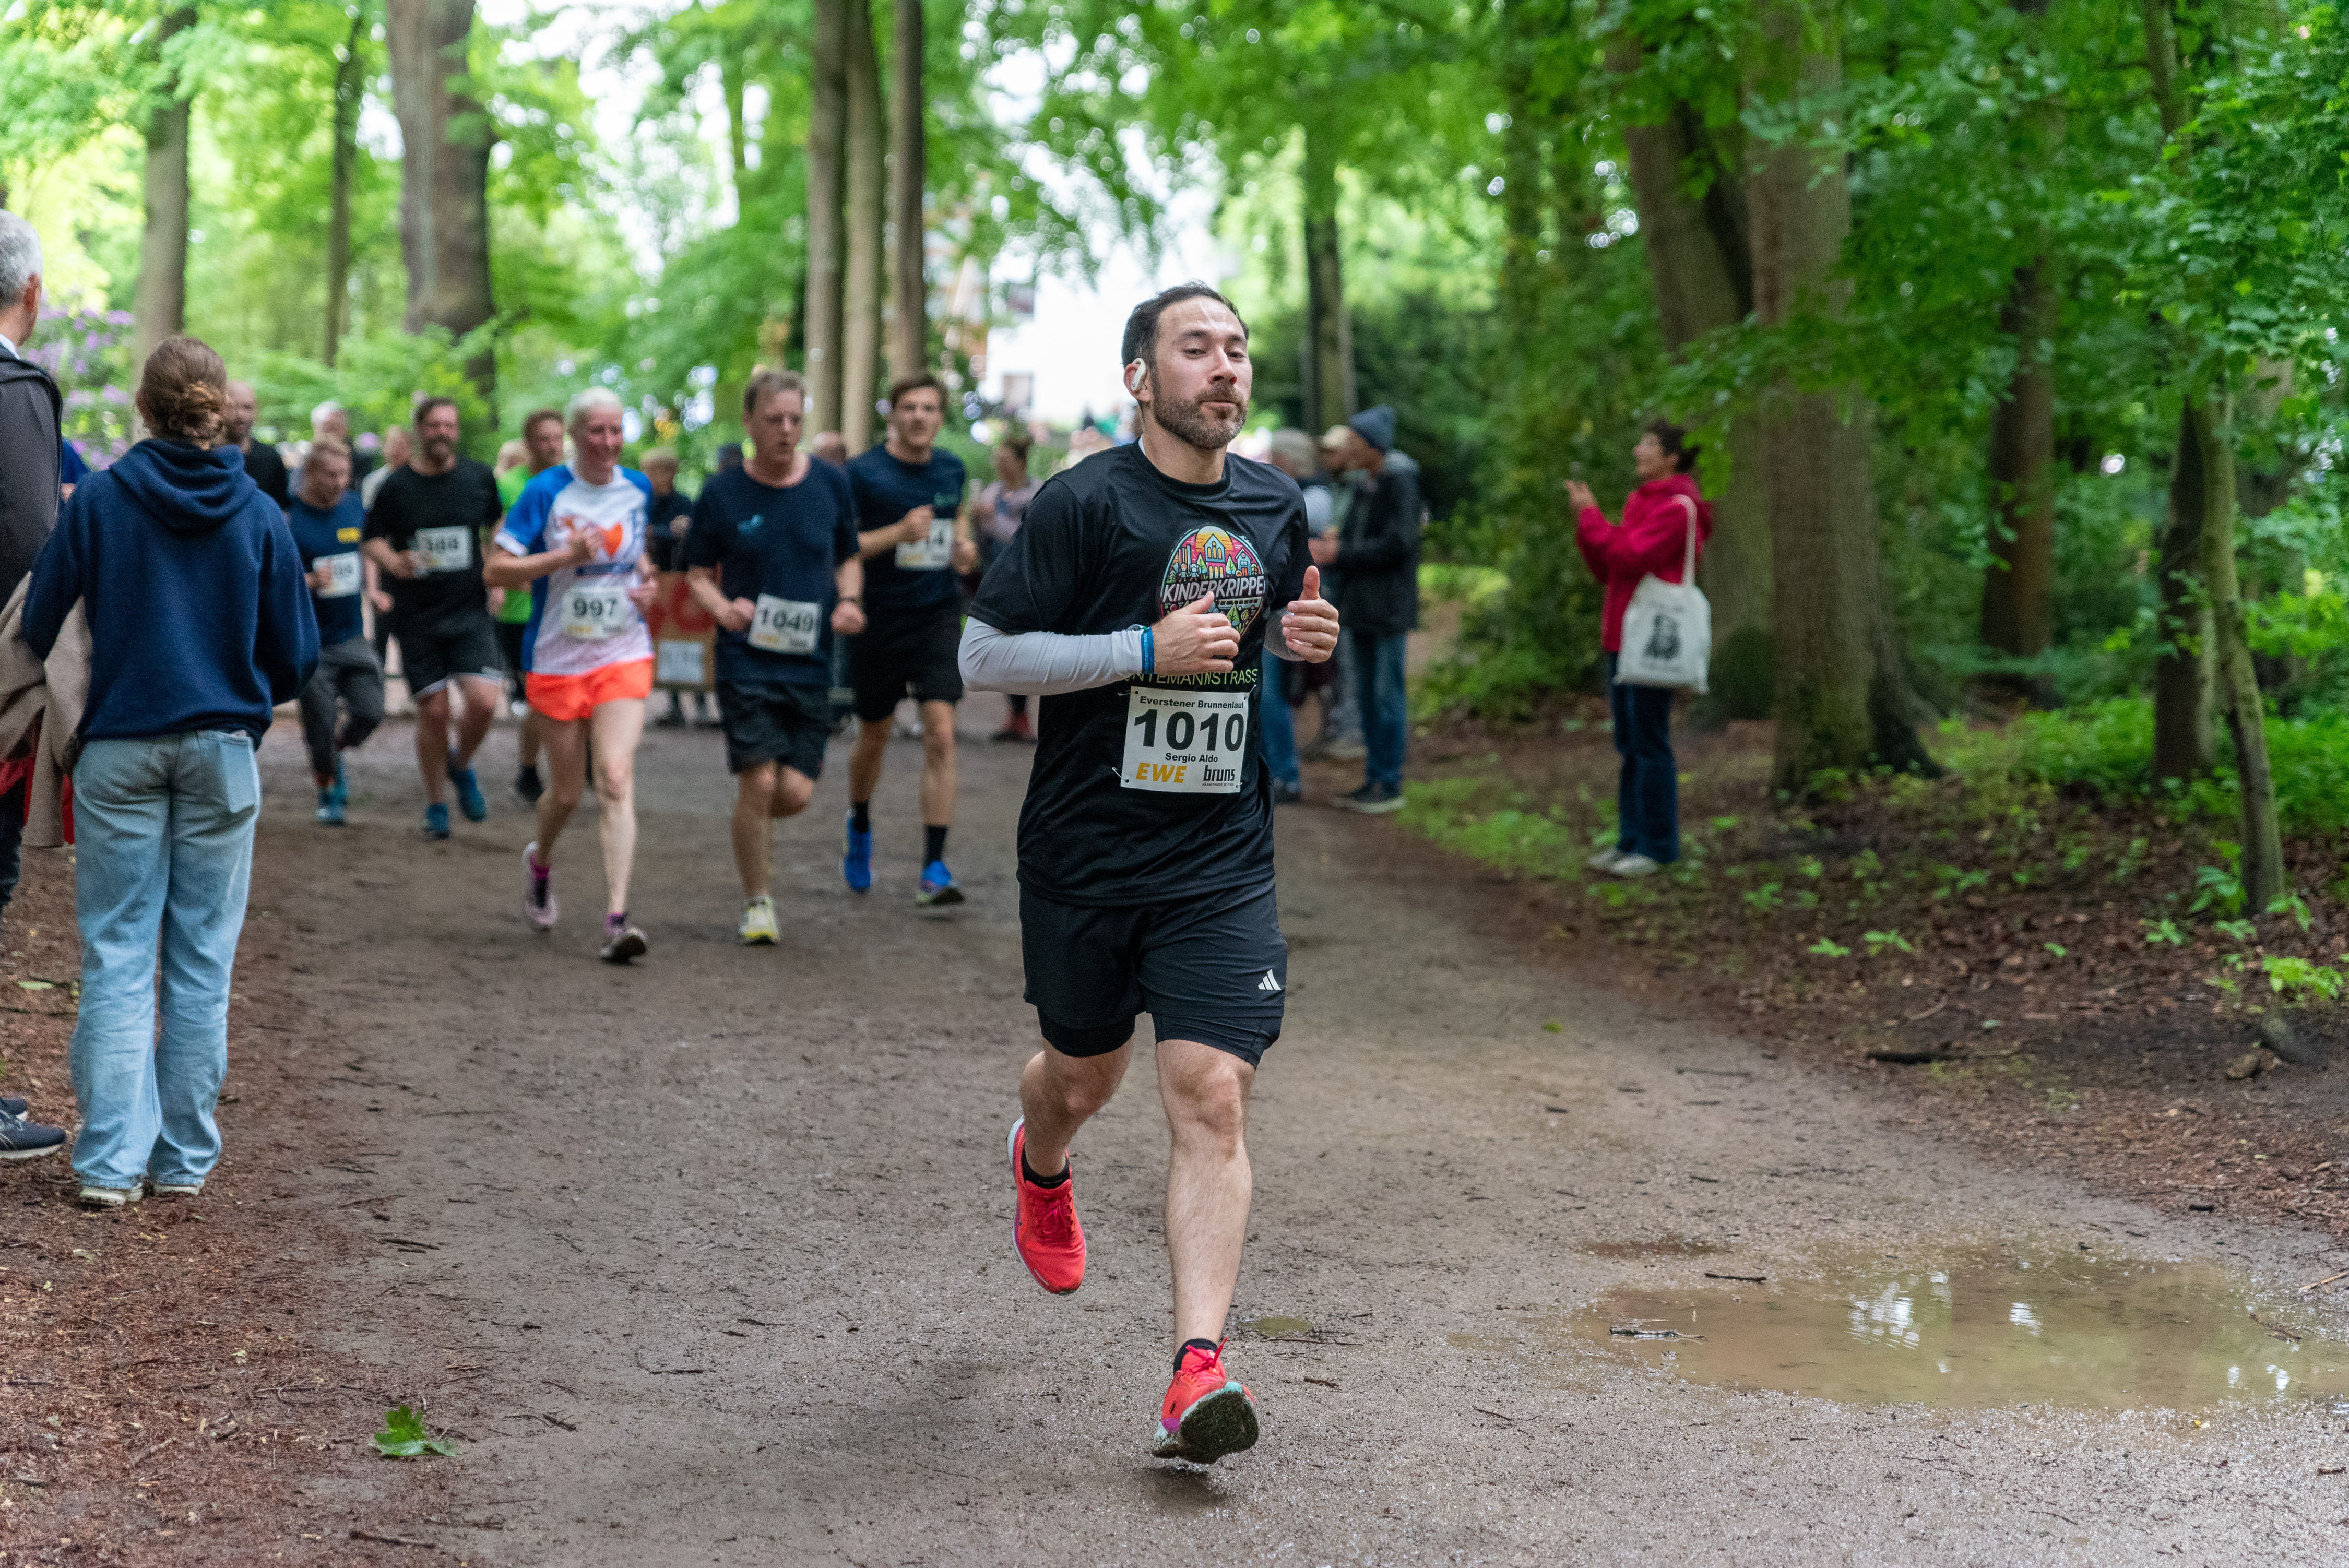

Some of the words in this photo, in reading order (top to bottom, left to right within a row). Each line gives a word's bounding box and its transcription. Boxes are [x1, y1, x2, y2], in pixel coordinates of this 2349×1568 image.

[1162, 575, 1264, 602] KINDERKRIPPE
[573, 598, 618, 618] 997
[758, 608, 814, 633] 1049
[1140, 696, 1195, 708] Everstener
[1197, 700, 1244, 709] Brunnenlauf
[1134, 709, 1244, 751] 1010
[1165, 753, 1196, 763] Sergio
[1199, 754, 1218, 763] Aldo
[1136, 762, 1187, 783] EWE
[1203, 765, 1236, 781] bruns
